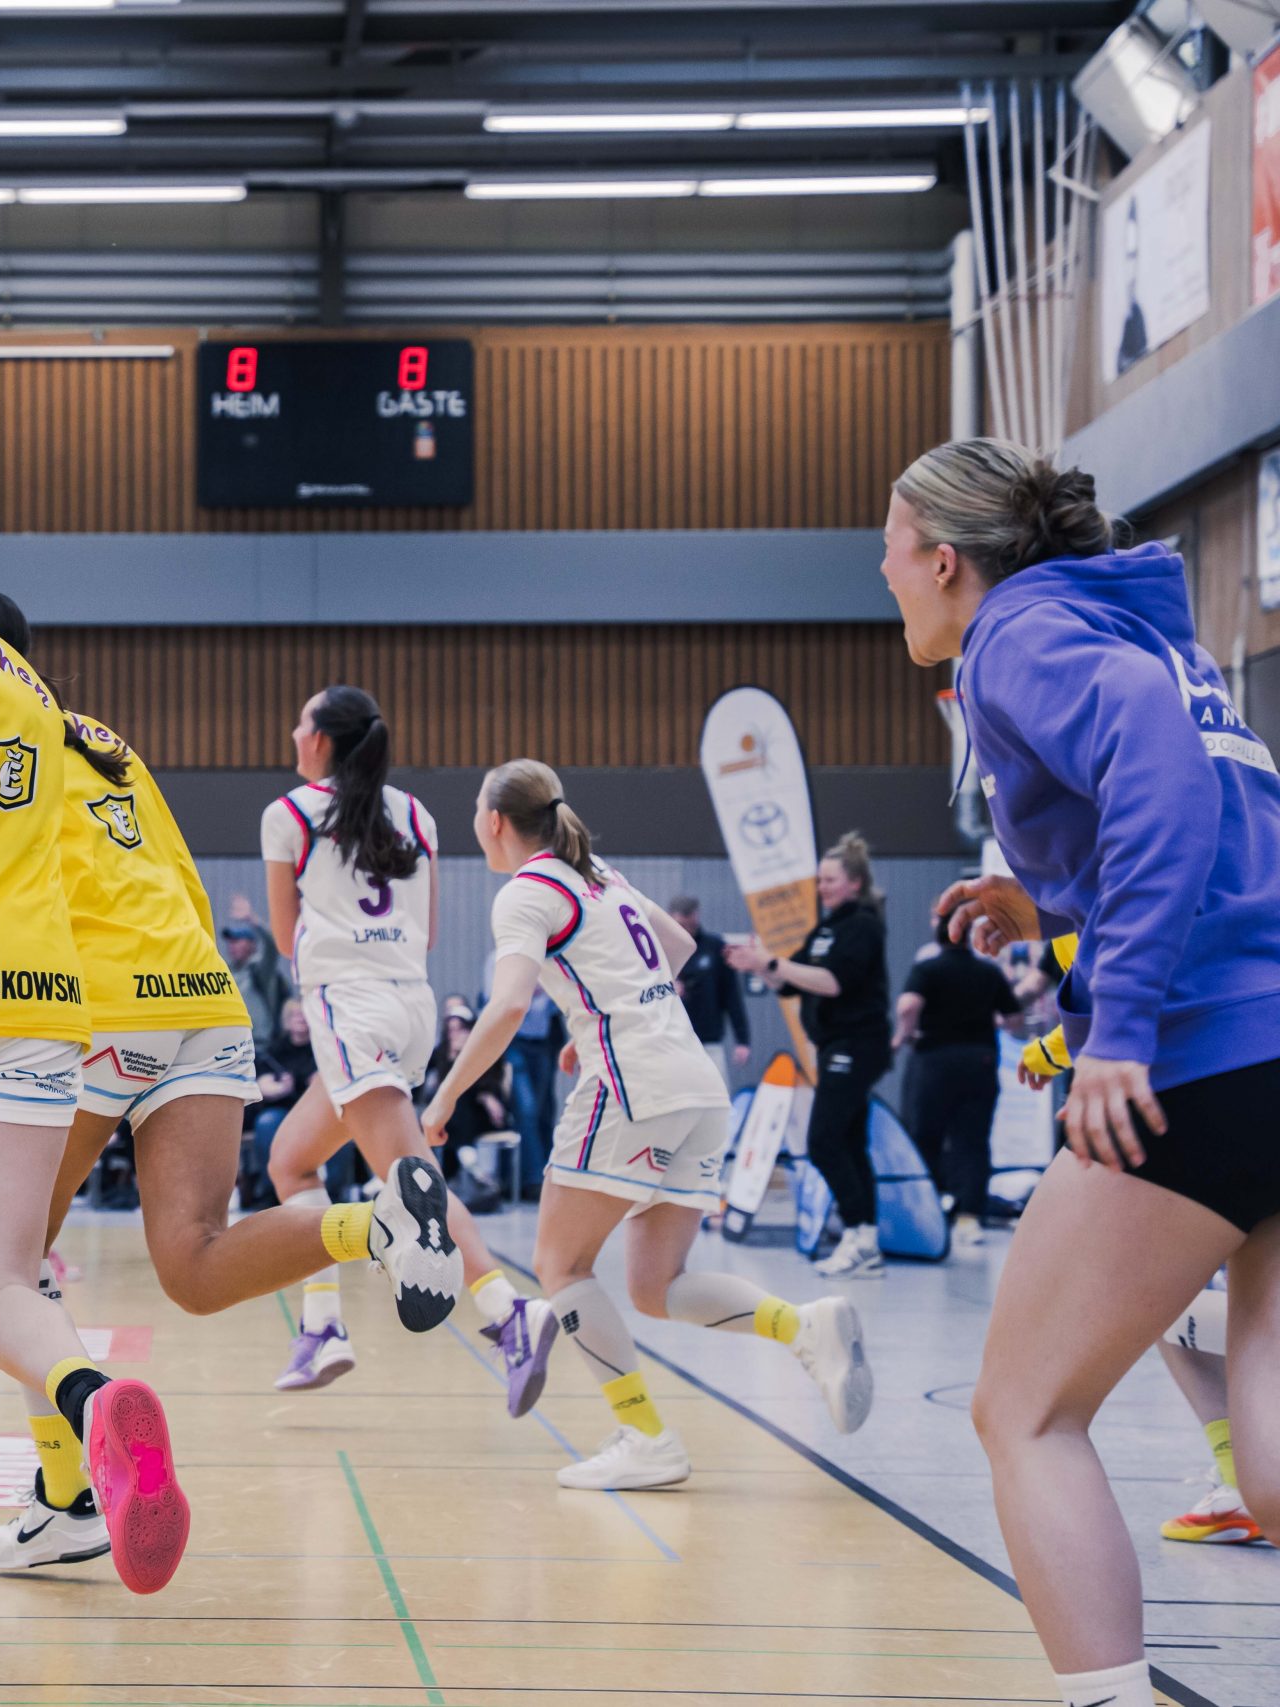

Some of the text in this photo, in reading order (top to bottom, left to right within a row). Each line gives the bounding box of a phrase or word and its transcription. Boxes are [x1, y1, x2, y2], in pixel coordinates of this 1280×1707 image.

[226, 347, 258, 392] 8
[398, 346, 428, 390] 8
[211, 392, 279, 417] HEIM
[619, 904, 660, 970] 6
[133, 972, 233, 998] ZOLLENKOPF
